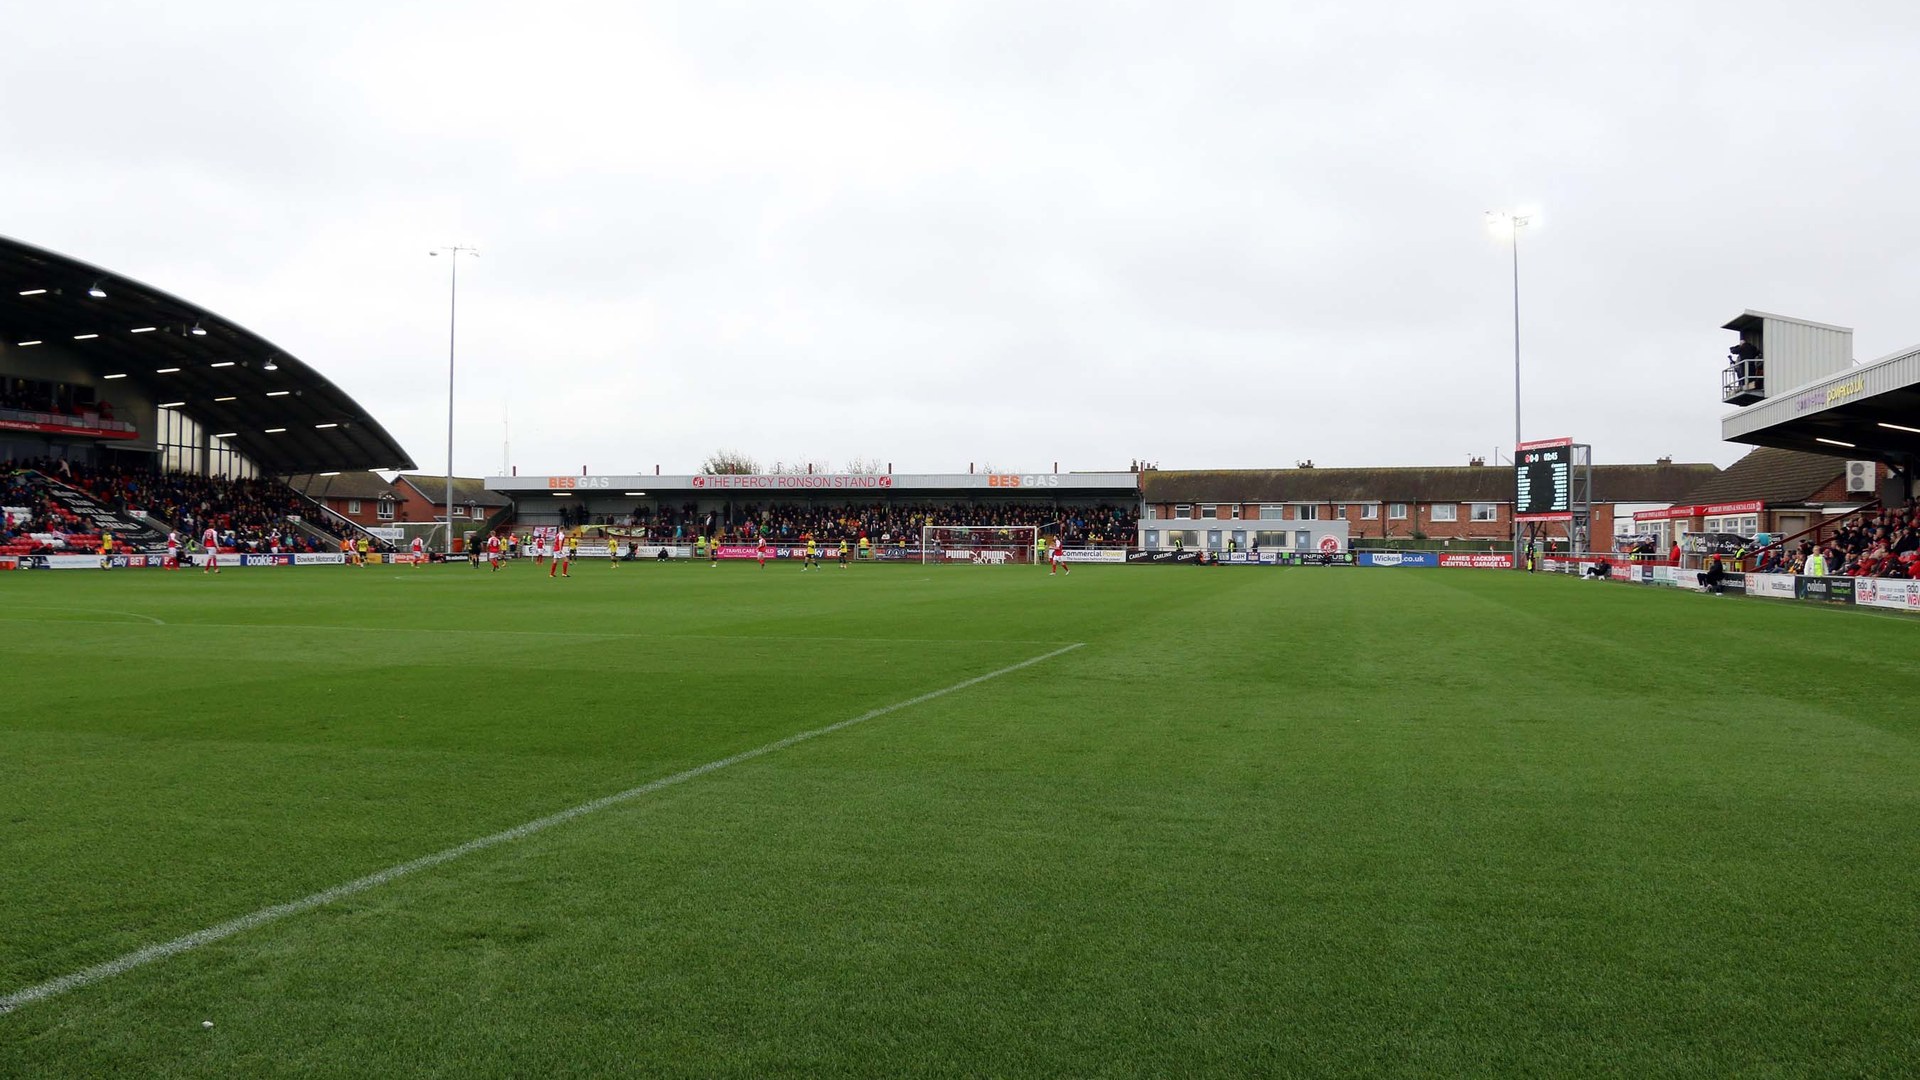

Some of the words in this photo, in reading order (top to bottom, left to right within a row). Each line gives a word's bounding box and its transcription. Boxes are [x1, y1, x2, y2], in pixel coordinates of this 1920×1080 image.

[550, 477, 575, 488] BES
[578, 477, 609, 488] GAS
[708, 477, 730, 487] THE
[734, 477, 774, 487] PERCY
[778, 477, 830, 488] RONSON
[834, 477, 876, 488] STAND
[988, 476, 1020, 487] BES
[1023, 476, 1058, 487] GAS
[777, 548, 790, 557] sky
[793, 548, 807, 556] BET
[814, 548, 824, 557] ky
[946, 550, 970, 558] PUMA
[981, 550, 1005, 559] PUMA
[1129, 551, 1148, 560] CARLING
[1153, 551, 1173, 560] CARLING
[114, 555, 128, 567] sky
[130, 556, 145, 565] BET
[148, 555, 162, 567] sky
[1858, 590, 1873, 601] wave
